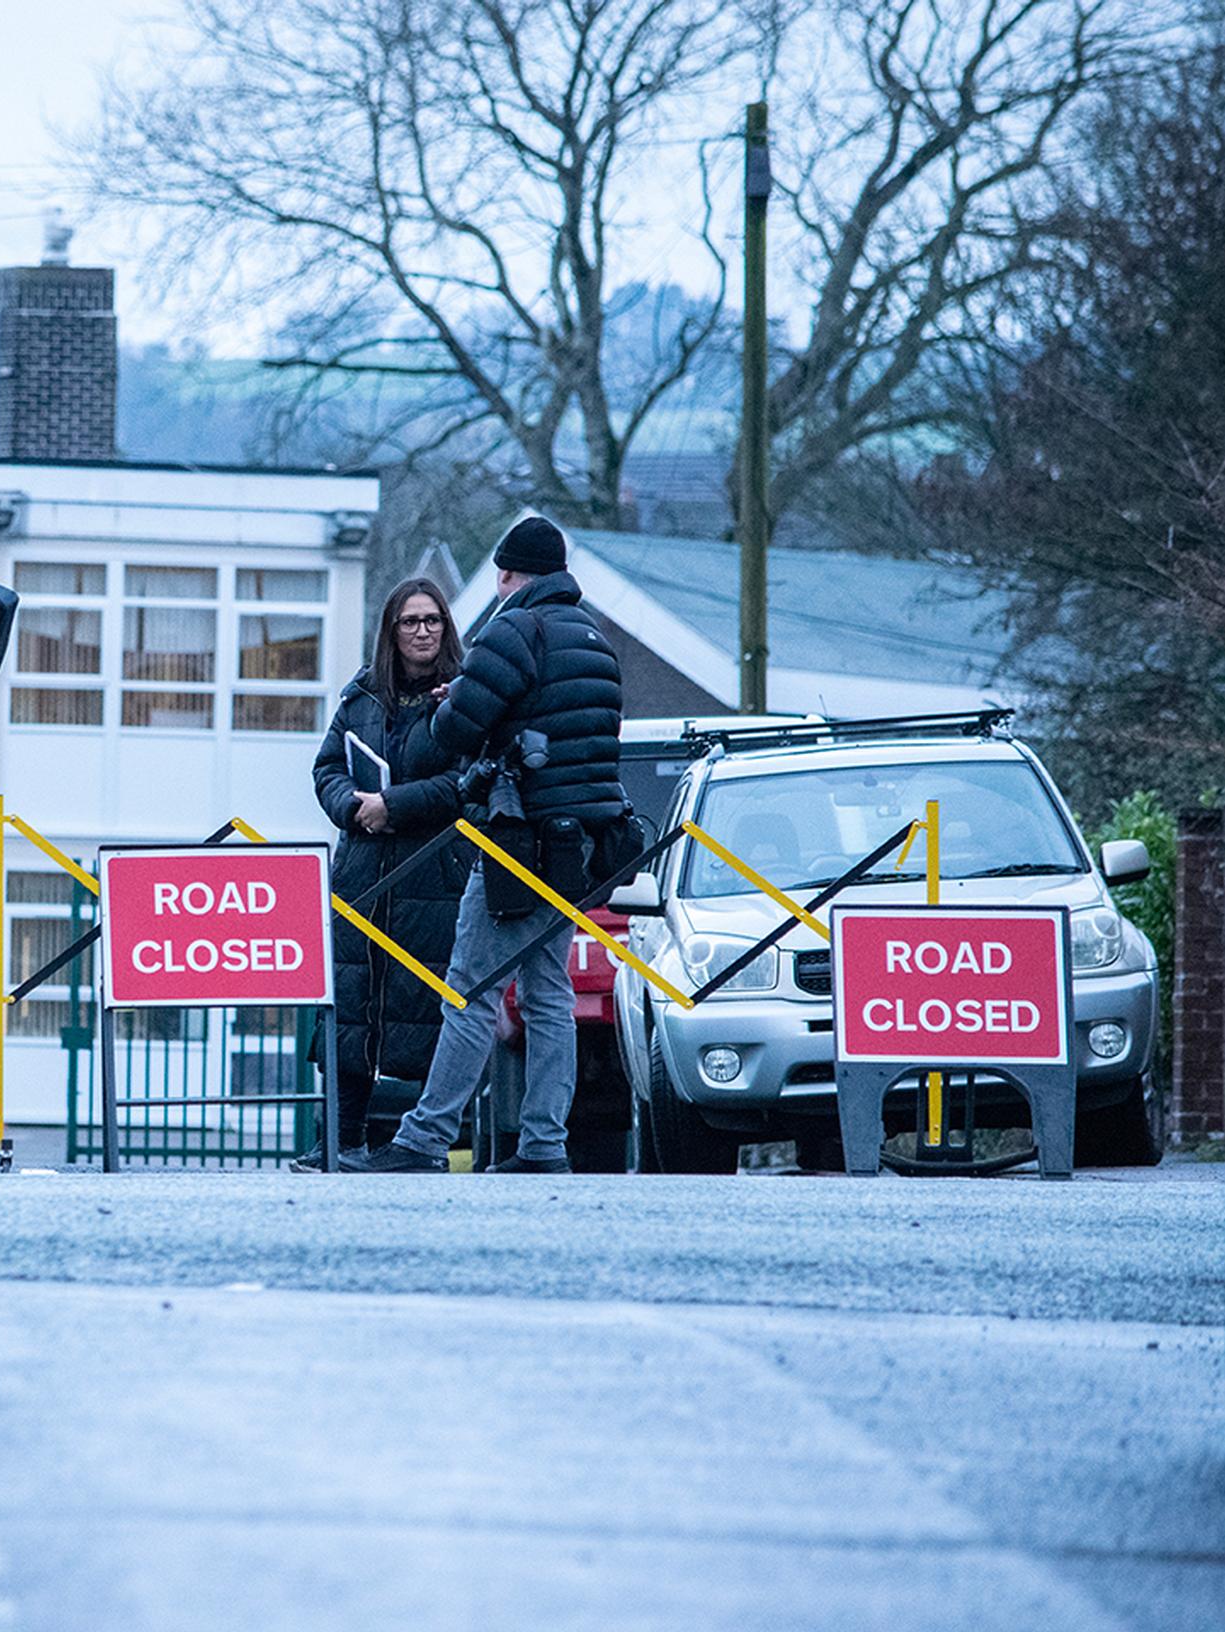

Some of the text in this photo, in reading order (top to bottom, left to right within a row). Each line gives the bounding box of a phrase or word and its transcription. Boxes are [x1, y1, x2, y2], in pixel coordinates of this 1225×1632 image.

[153, 881, 277, 915] ROAD
[131, 938, 304, 974] CLOSED
[886, 940, 1012, 975] ROAD
[862, 998, 1041, 1033] CLOSED
